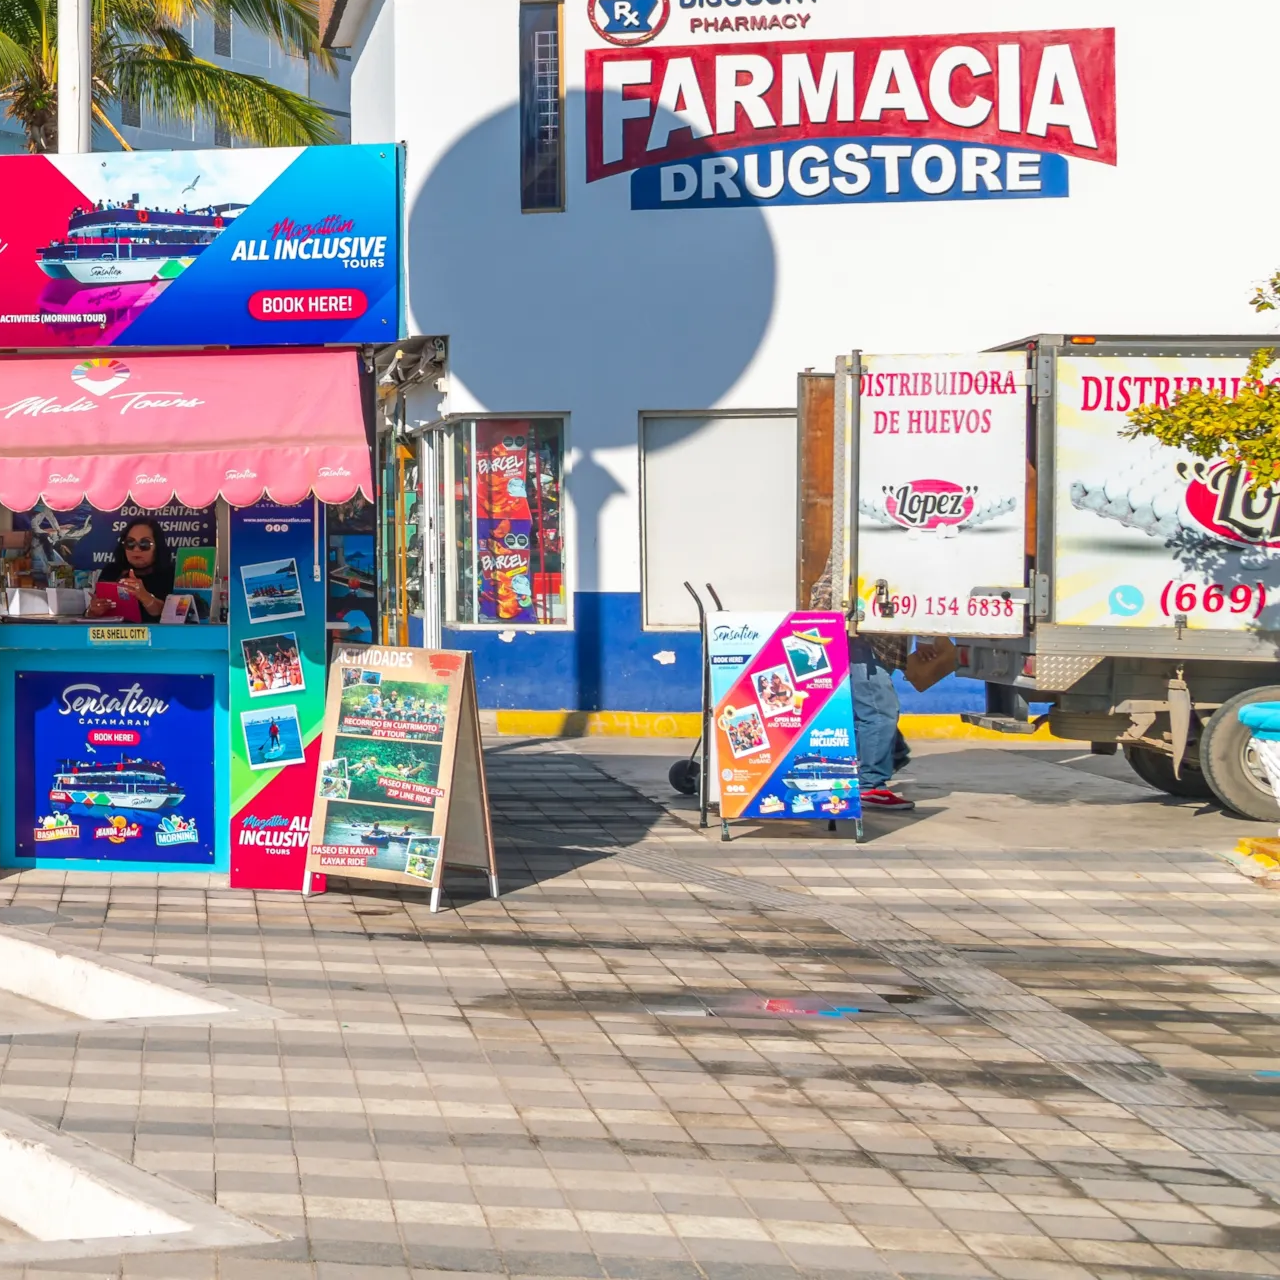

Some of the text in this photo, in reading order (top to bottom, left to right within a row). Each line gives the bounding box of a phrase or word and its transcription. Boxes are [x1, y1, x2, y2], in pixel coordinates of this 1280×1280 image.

[689, 12, 812, 34] PHARMACY
[601, 42, 1100, 166] FARMACIA
[659, 143, 1044, 204] DRUGSTORE
[230, 235, 387, 262] ALL INCLUSIVE
[342, 258, 385, 269] TOURS
[262, 294, 353, 314] BOOK HERE!
[0, 314, 40, 323] ACTIVITIES
[41, 314, 82, 323] (MORNING
[83, 314, 106, 323] TOUR)
[108, 391, 206, 415] Tours
[873, 409, 992, 434] DE HUEVOS
[477, 455, 524, 475] BARCEL
[120, 505, 200, 517] BOAT RENTAL
[481, 554, 528, 571] BARCEL
[872, 594, 1014, 618] (69) 154 6838
[1160, 580, 1267, 619] (669)
[92, 628, 146, 639] SEA SHELL CITY
[712, 624, 760, 642] Sensation
[335, 647, 413, 668] ACTIVIDADES
[58, 682, 170, 718] Sensation
[78, 718, 150, 726] CATAMARAN
[344, 718, 437, 731] RECORRIDO EN CUATRIMOTO
[93, 733, 134, 742] BOOK HERE!
[834, 728, 848, 737] ALL
[809, 737, 849, 747] INCLUSIVE
[379, 778, 444, 796] PASEO EN TIROLESA
[387, 789, 432, 804] ZIP LINE RIDE
[55, 827, 77, 838] PARTY
[158, 831, 195, 843] MORNING
[238, 830, 310, 847] INCLUSIV
[312, 846, 376, 855] PASEO EN KAYAK
[321, 857, 366, 866] KAYAK RIDE
